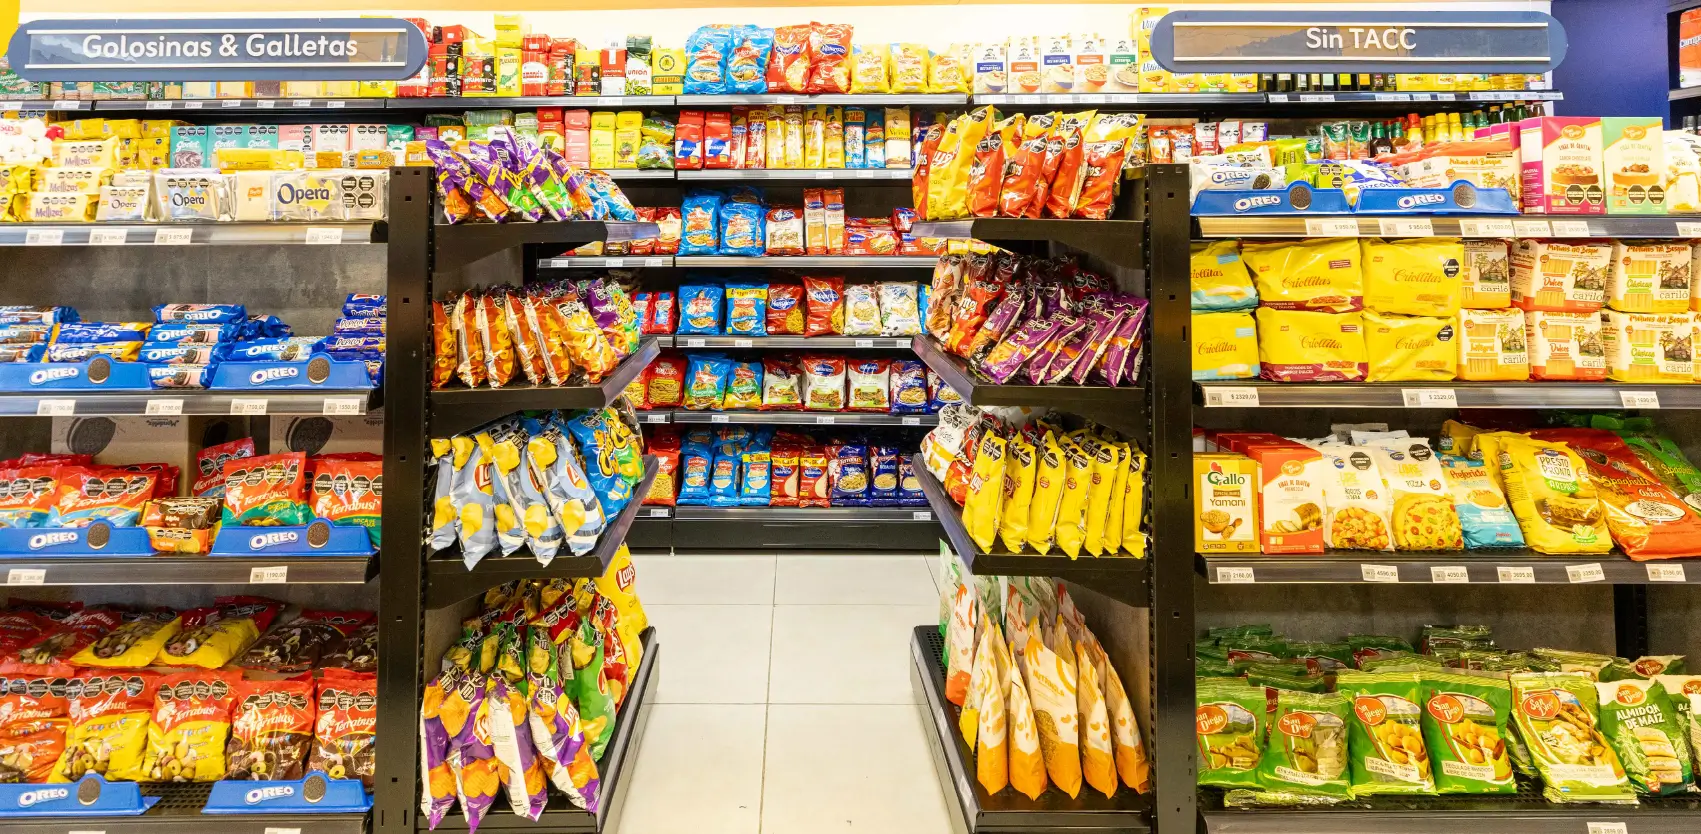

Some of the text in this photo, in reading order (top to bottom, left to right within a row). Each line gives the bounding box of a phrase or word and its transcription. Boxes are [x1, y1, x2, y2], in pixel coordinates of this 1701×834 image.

[1306, 27, 1417, 49] Sin TACC
[83, 33, 358, 58] Golosinas & Galletas
[1212, 171, 1251, 183] OREO
[172, 193, 205, 206] Opera
[277, 183, 330, 204] Opera
[111, 199, 137, 210] Opera
[1234, 195, 1281, 211] OREO
[1398, 194, 1445, 208] OREO
[35, 204, 63, 217] Mellizas
[1281, 275, 1331, 289] Criollitas
[1393, 268, 1442, 283] Criollitas
[1480, 284, 1509, 293] cariló
[1659, 290, 1688, 299] cariló
[1572, 291, 1603, 302] cariló
[157, 329, 195, 342] OREO
[1299, 334, 1343, 349] Criollitas
[1196, 341, 1237, 355] Criollitas
[1395, 336, 1434, 350] Criollitas
[148, 348, 187, 360] OREO
[246, 344, 287, 356] OREO
[1503, 354, 1527, 364] cariló
[1581, 358, 1605, 368] cariló
[1665, 363, 1691, 373] cariló
[31, 368, 79, 385] OREO
[250, 367, 298, 384] OREO
[1539, 456, 1569, 469] PRESTO
[1450, 469, 1487, 479] Preferido
[1542, 465, 1572, 478] PRONTA
[1208, 471, 1245, 486] Gallo
[1549, 480, 1578, 492] AREPAS
[29, 532, 78, 549] OREO
[250, 532, 298, 549] OREO
[1433, 699, 1450, 711] San
[1529, 698, 1544, 710] San
[1616, 704, 1660, 721] ALMIDÓN
[1200, 715, 1223, 732] Diego
[1283, 715, 1300, 726] San
[1626, 711, 1665, 729] DE MAÍZ
[19, 787, 68, 807] OREO
[245, 786, 295, 806] OREO
